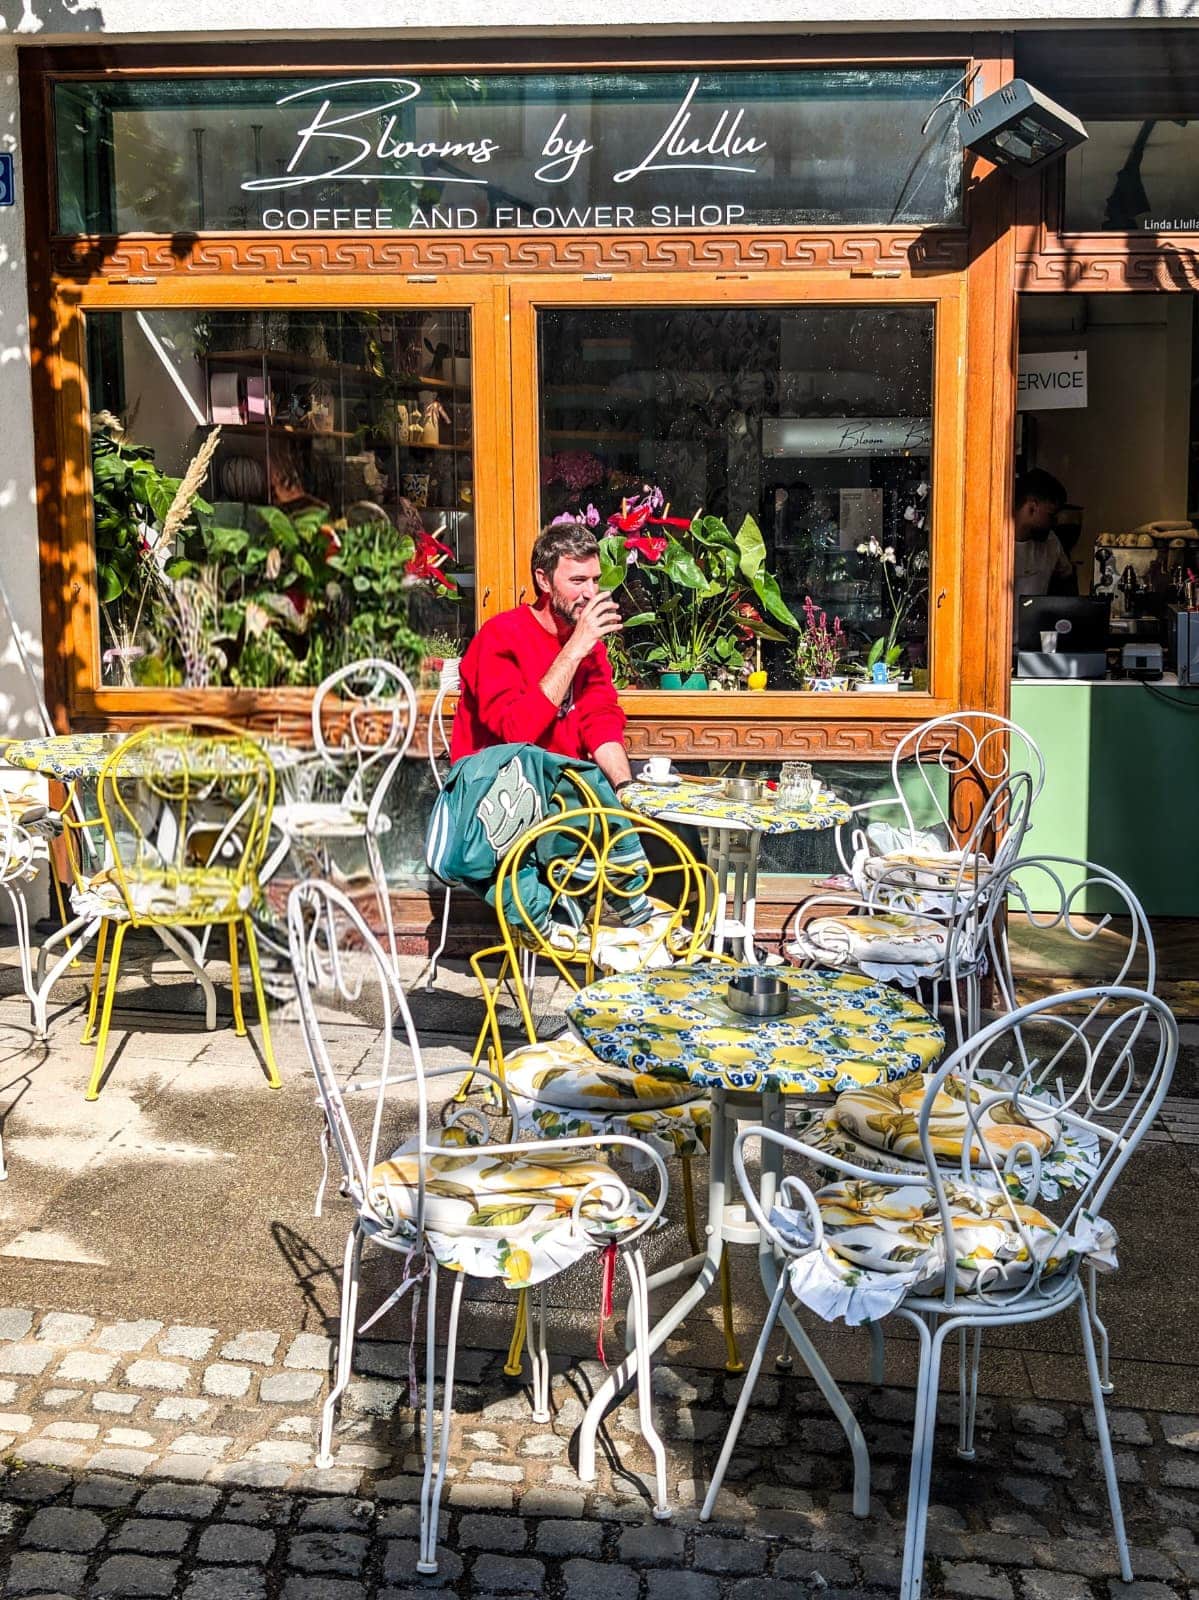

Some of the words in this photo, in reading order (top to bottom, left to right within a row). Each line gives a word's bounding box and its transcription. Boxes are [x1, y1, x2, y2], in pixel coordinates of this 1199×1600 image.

[241, 77, 499, 191] Blooms
[535, 113, 593, 183] by
[262, 208, 393, 230] COFFEE
[408, 207, 478, 229] AND
[496, 206, 635, 229] FLOWER
[651, 204, 745, 227] SHOP
[1144, 219, 1172, 230] Linda
